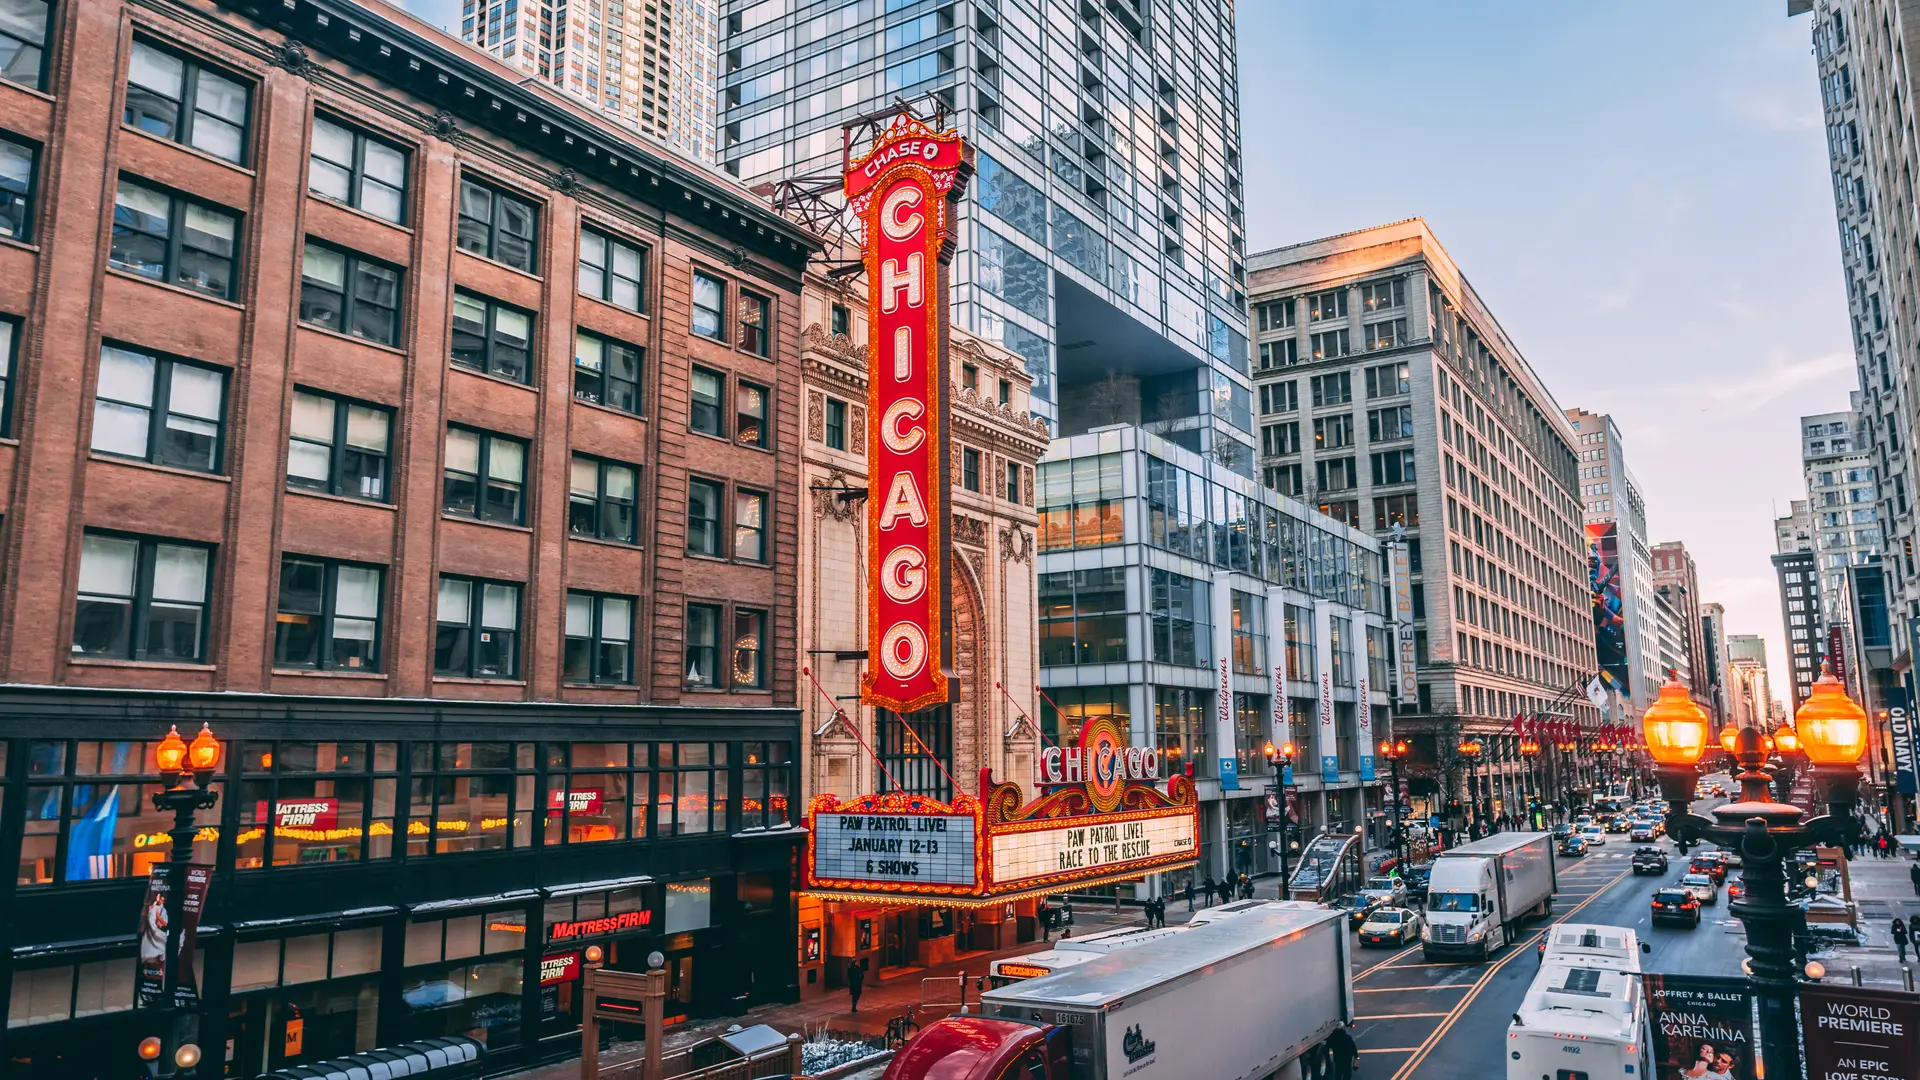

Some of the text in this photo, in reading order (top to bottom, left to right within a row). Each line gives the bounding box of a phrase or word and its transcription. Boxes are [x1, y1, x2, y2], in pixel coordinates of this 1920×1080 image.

[864, 141, 921, 177] CHASE
[880, 185, 929, 681] CHICAGO
[1395, 544, 1417, 701] JOFFREY BALLET
[1833, 637, 1842, 655] STATE
[1218, 657, 1231, 722] Walgreens
[1273, 665, 1286, 725] Walgreens
[1320, 672, 1332, 726] Walgreens
[1359, 678, 1370, 729] Walgreens
[1890, 706, 1913, 773] OLD NAVY
[1042, 746, 1158, 783] CHICAGO
[555, 792, 597, 802] MTTRESS
[281, 813, 316, 826] FIRM
[840, 816, 947, 832] PAW PATROL LIVE!
[1067, 822, 1144, 848] PAW PATROL LIVE!
[848, 838, 938, 854] JANUARY 12-13
[1060, 839, 1151, 870] RACE TO THE RESCUE
[866, 859, 919, 876] 6 SHOWS
[541, 966, 564, 980] FIRM
[1653, 990, 1742, 1001] JOFFREY BALLET
[1057, 1012, 1085, 1025] 161675
[1659, 1011, 1709, 1026] ANNA
[1827, 1003, 1891, 1020] WORLD
[1661, 1024, 1746, 1043] KARENINA
[1818, 1016, 1904, 1036] PREMIERE
[287, 1031, 297, 1043] M
[1562, 1045, 1581, 1055] 4192
[1837, 1058, 1889, 1072] AN EPIC
